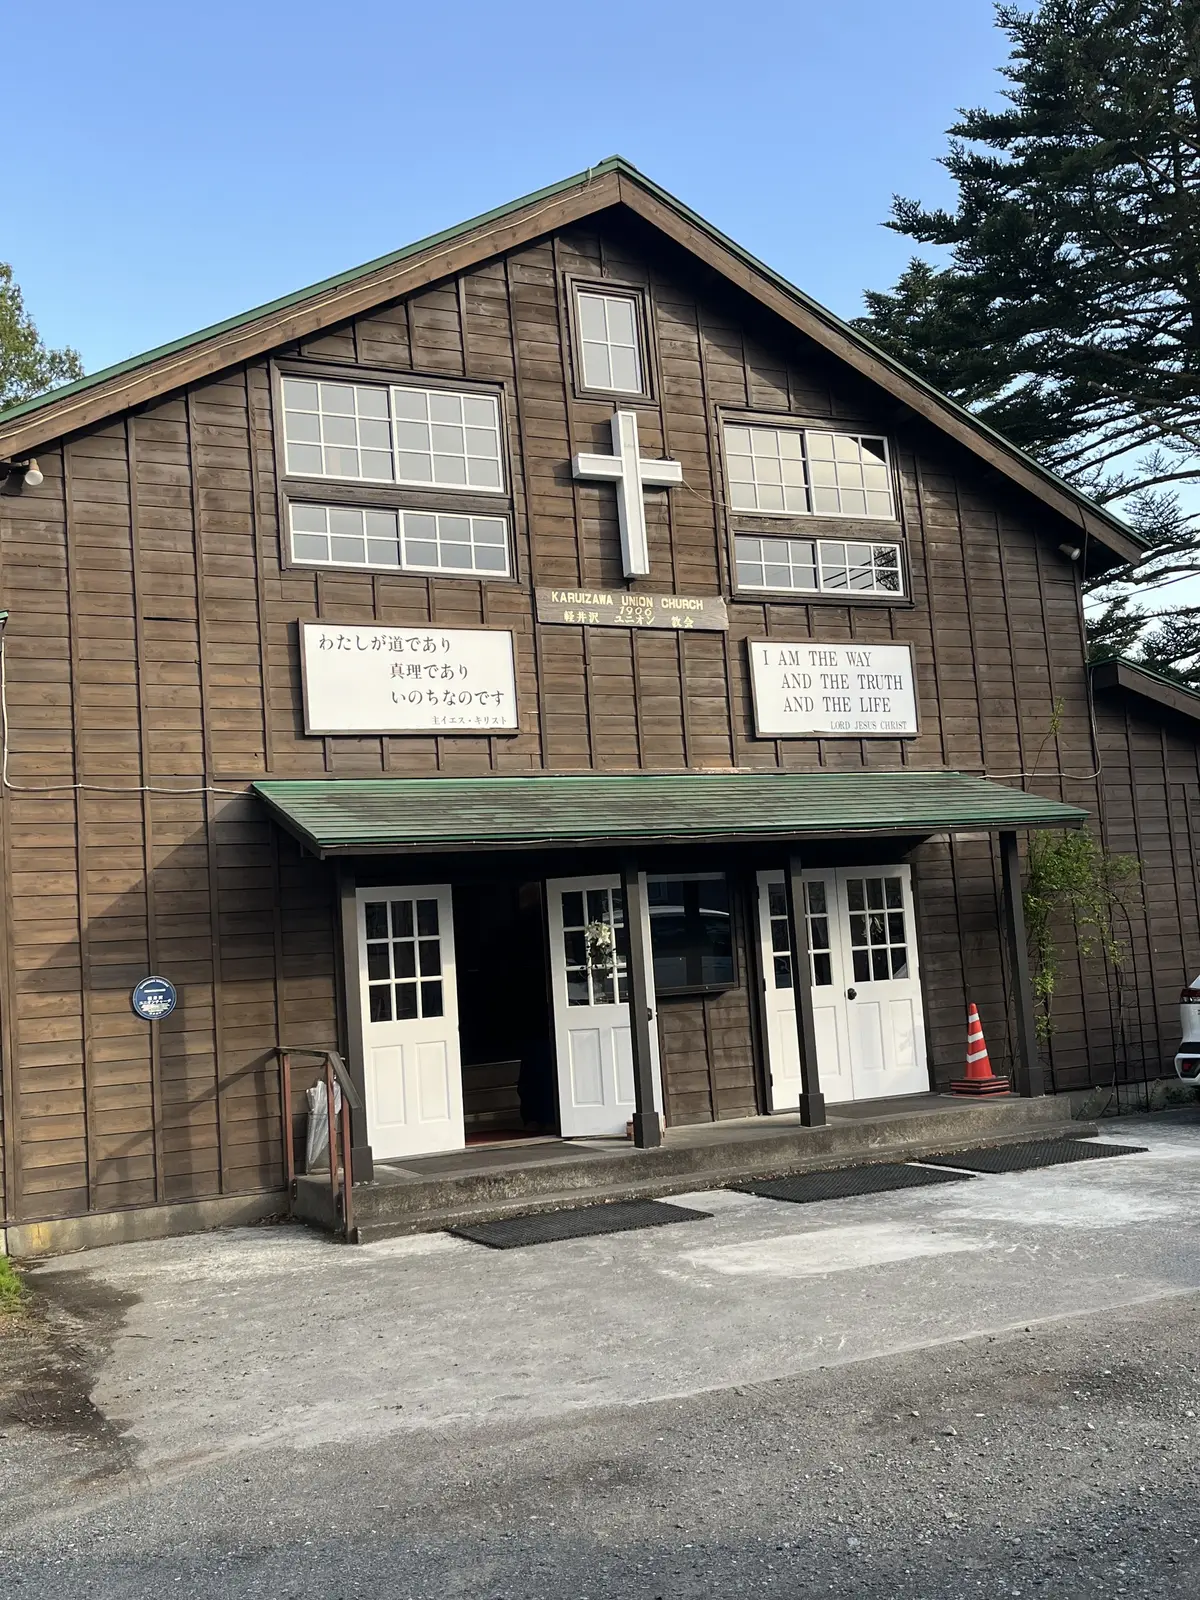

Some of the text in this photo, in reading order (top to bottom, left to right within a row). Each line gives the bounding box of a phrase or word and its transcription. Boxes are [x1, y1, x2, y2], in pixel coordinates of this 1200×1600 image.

[551, 590, 704, 611] KARUIZAWA UNION CHURCH
[563, 610, 695, 629] 軽井沢 ユニオン 教会
[619, 606, 652, 617] 1906
[319, 633, 451, 653] わたしが道であり
[763, 649, 872, 667] I AM THE WAY
[389, 663, 468, 680] 真理であり
[781, 673, 904, 691] AND THE TRUTH
[391, 689, 505, 707] いのちなのです
[783, 696, 891, 713] AND THE LIFE
[431, 715, 507, 726] 主イエス・キリスト
[830, 720, 907, 730] LORD JESUS CHRIST
